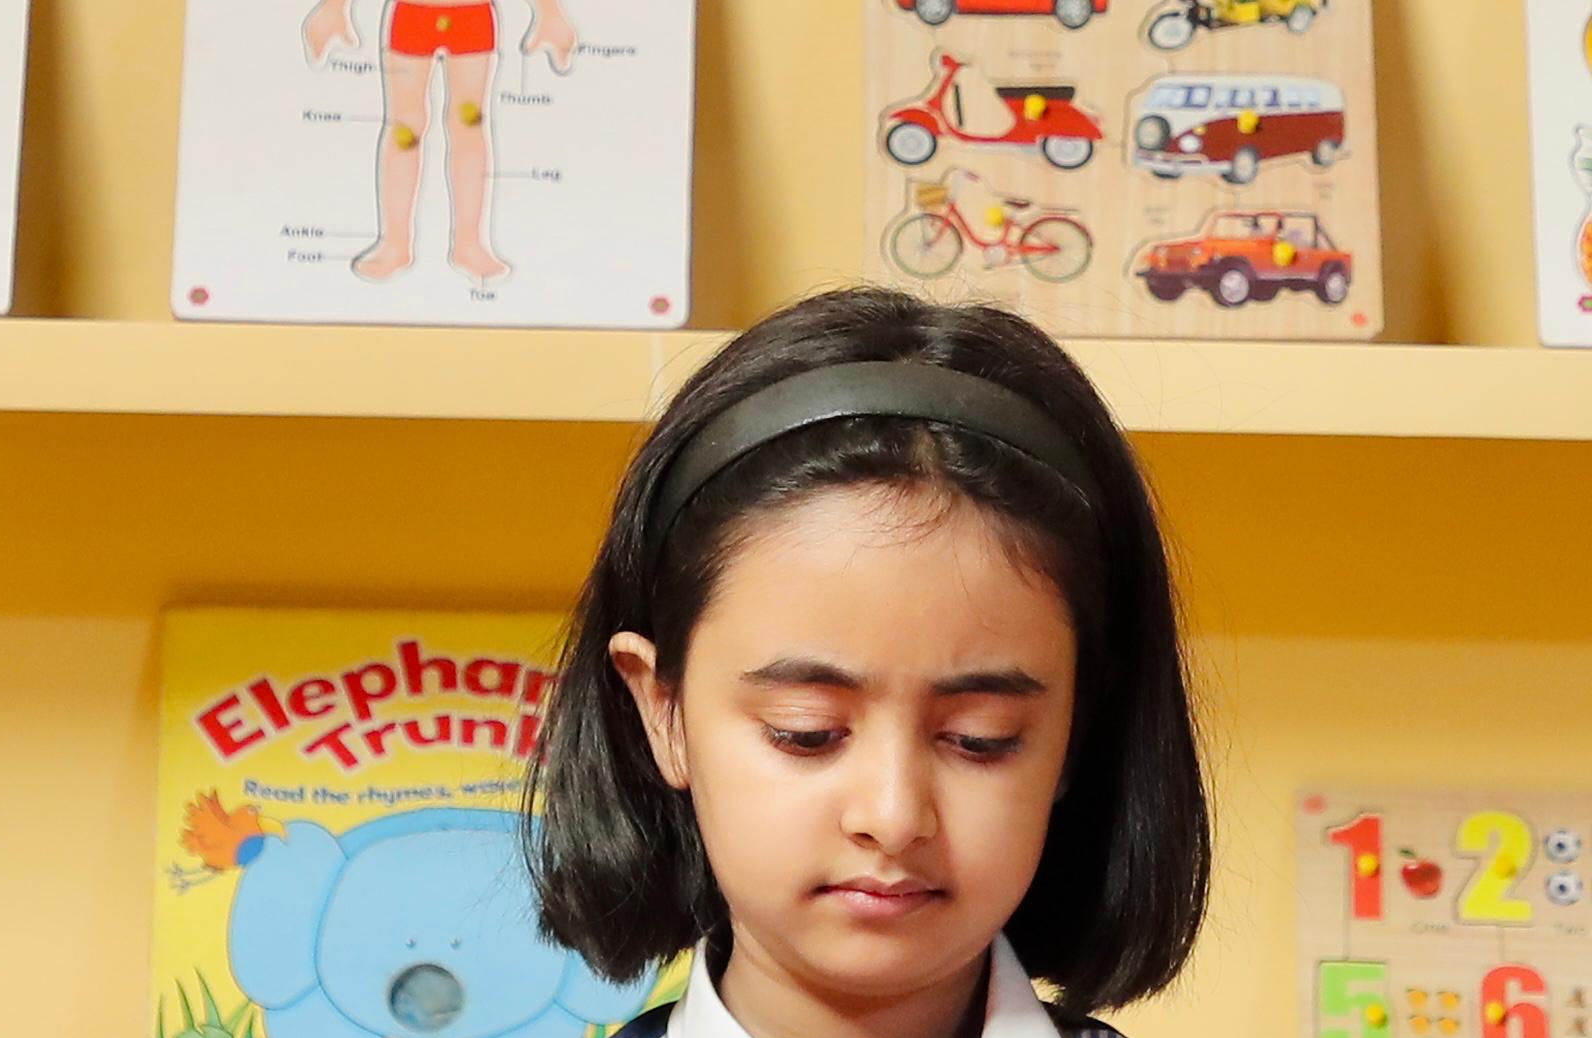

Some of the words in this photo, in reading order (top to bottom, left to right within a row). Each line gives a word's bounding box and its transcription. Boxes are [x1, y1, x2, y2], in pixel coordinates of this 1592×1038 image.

[244, 779, 305, 802] Read
[312, 786, 349, 804] the
[1329, 816, 1384, 920] 1
[1461, 811, 1535, 921] 2
